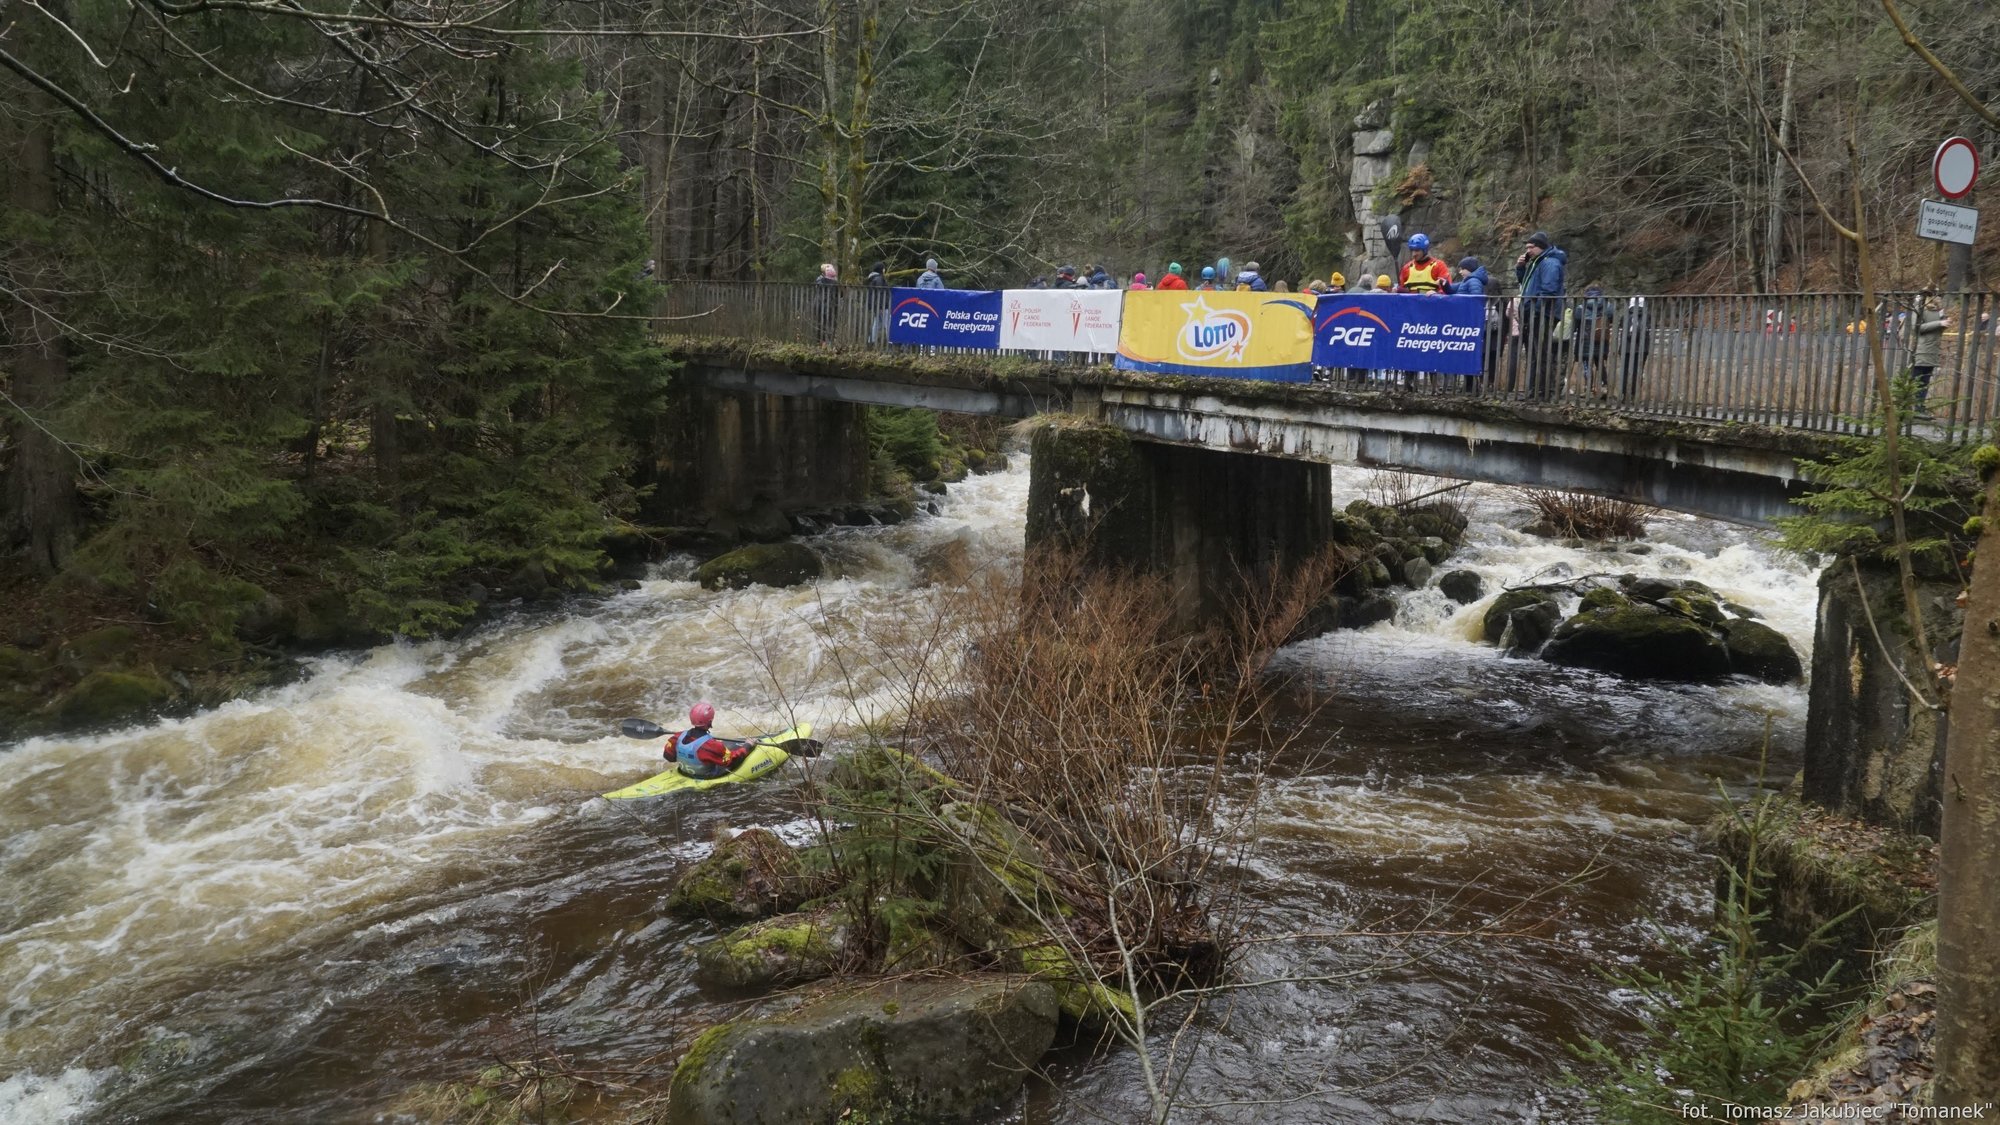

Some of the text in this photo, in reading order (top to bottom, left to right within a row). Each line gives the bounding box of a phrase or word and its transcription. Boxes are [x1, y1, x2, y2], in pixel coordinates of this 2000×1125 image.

[898, 312, 930, 328] PGE
[945, 310, 999, 323] Polska Grupa
[942, 321, 996, 334] Energetyczna
[1194, 321, 1236, 348] LOTTO
[1401, 322, 1481, 339] Polska Grupa
[1328, 326, 1376, 347] PGE
[1396, 336, 1476, 353] Energetyczna
